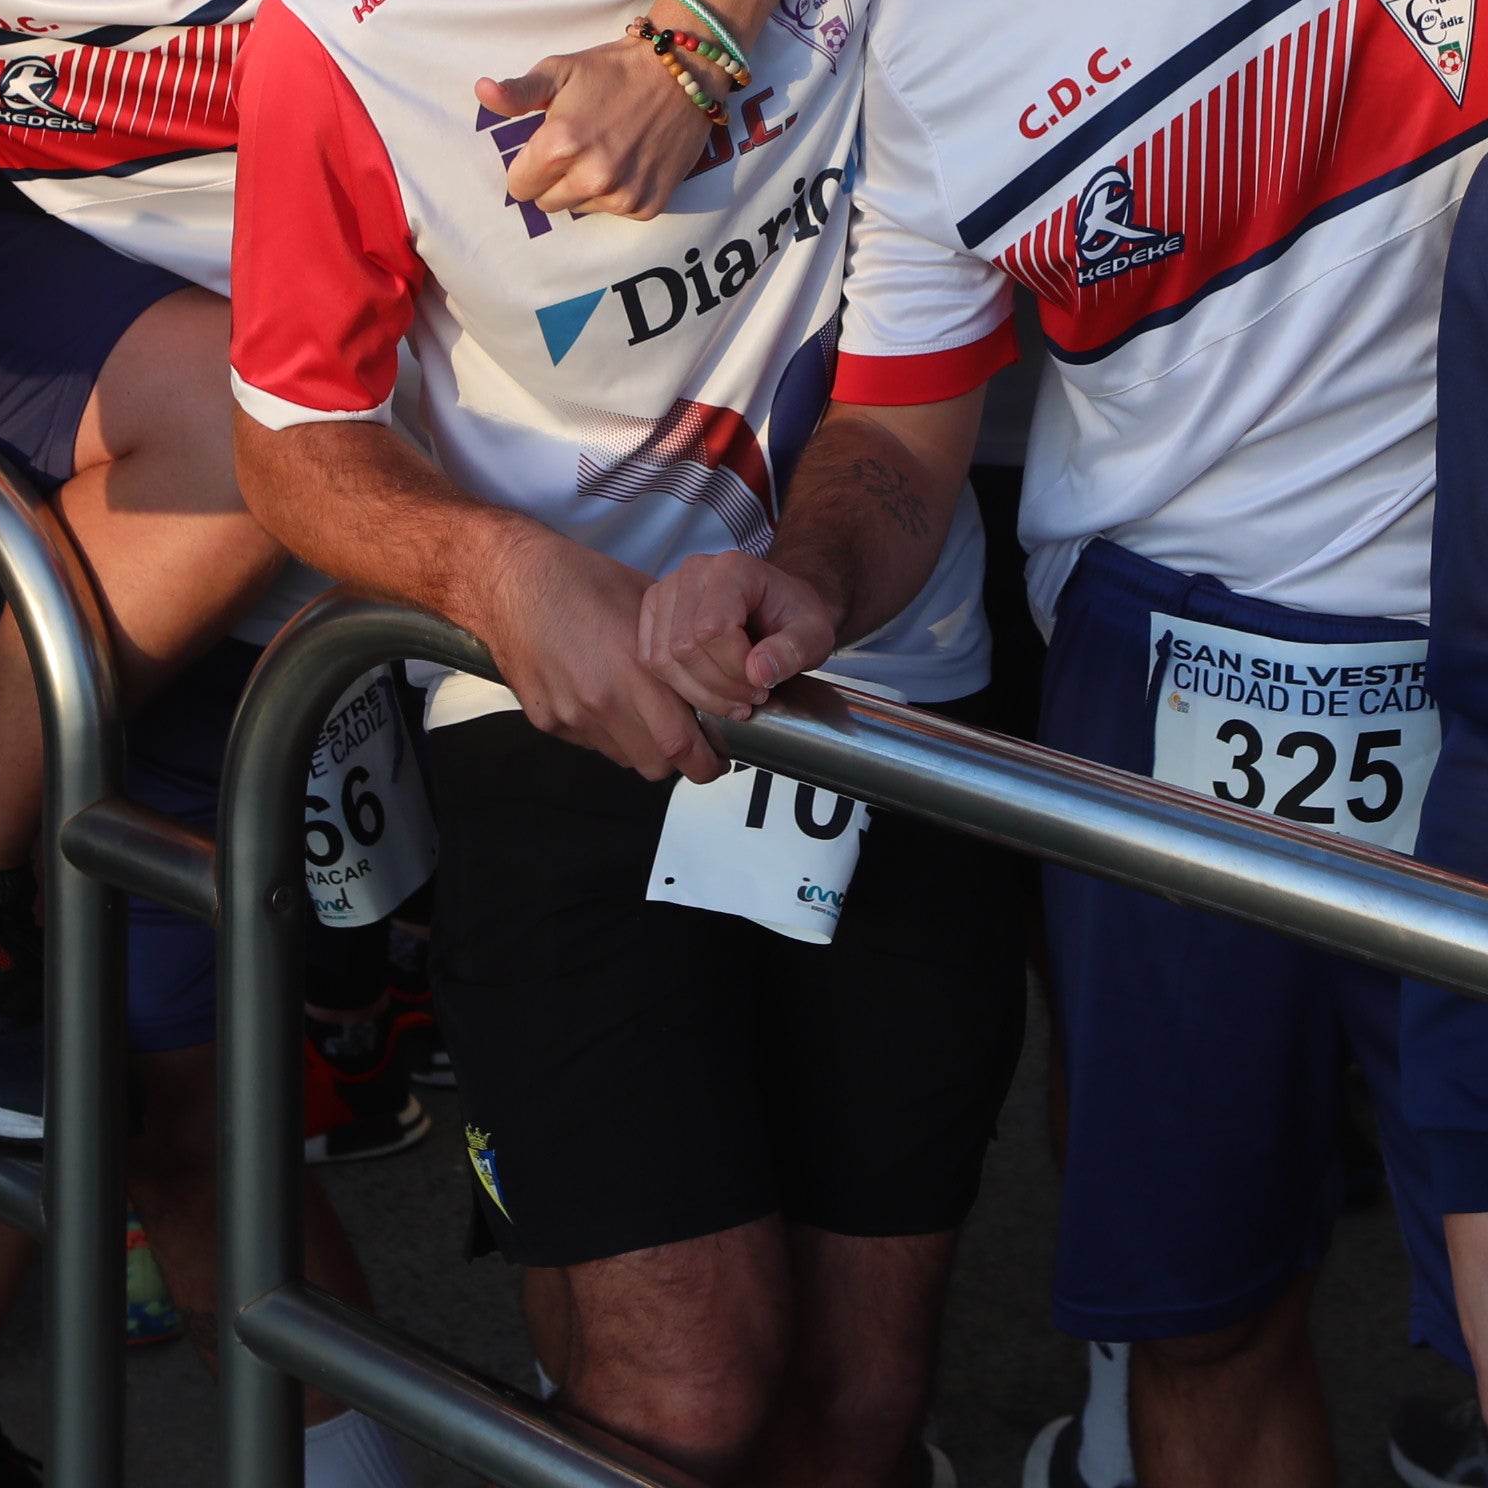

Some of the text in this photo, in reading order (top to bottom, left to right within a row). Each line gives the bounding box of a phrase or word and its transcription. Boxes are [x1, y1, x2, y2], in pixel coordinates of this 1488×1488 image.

[1018, 46, 1132, 139] C.D.C.
[612, 165, 844, 346] Diario
[1078, 236, 1181, 285] KEDEKE
[1173, 638, 1242, 672] SAN
[314, 683, 380, 750] ESTRE
[1173, 683, 1436, 718] CIUDAD DE CADI
[309, 701, 388, 779] E CADIZ
[1212, 718, 1403, 824] 325
[734, 762, 858, 840] 10
